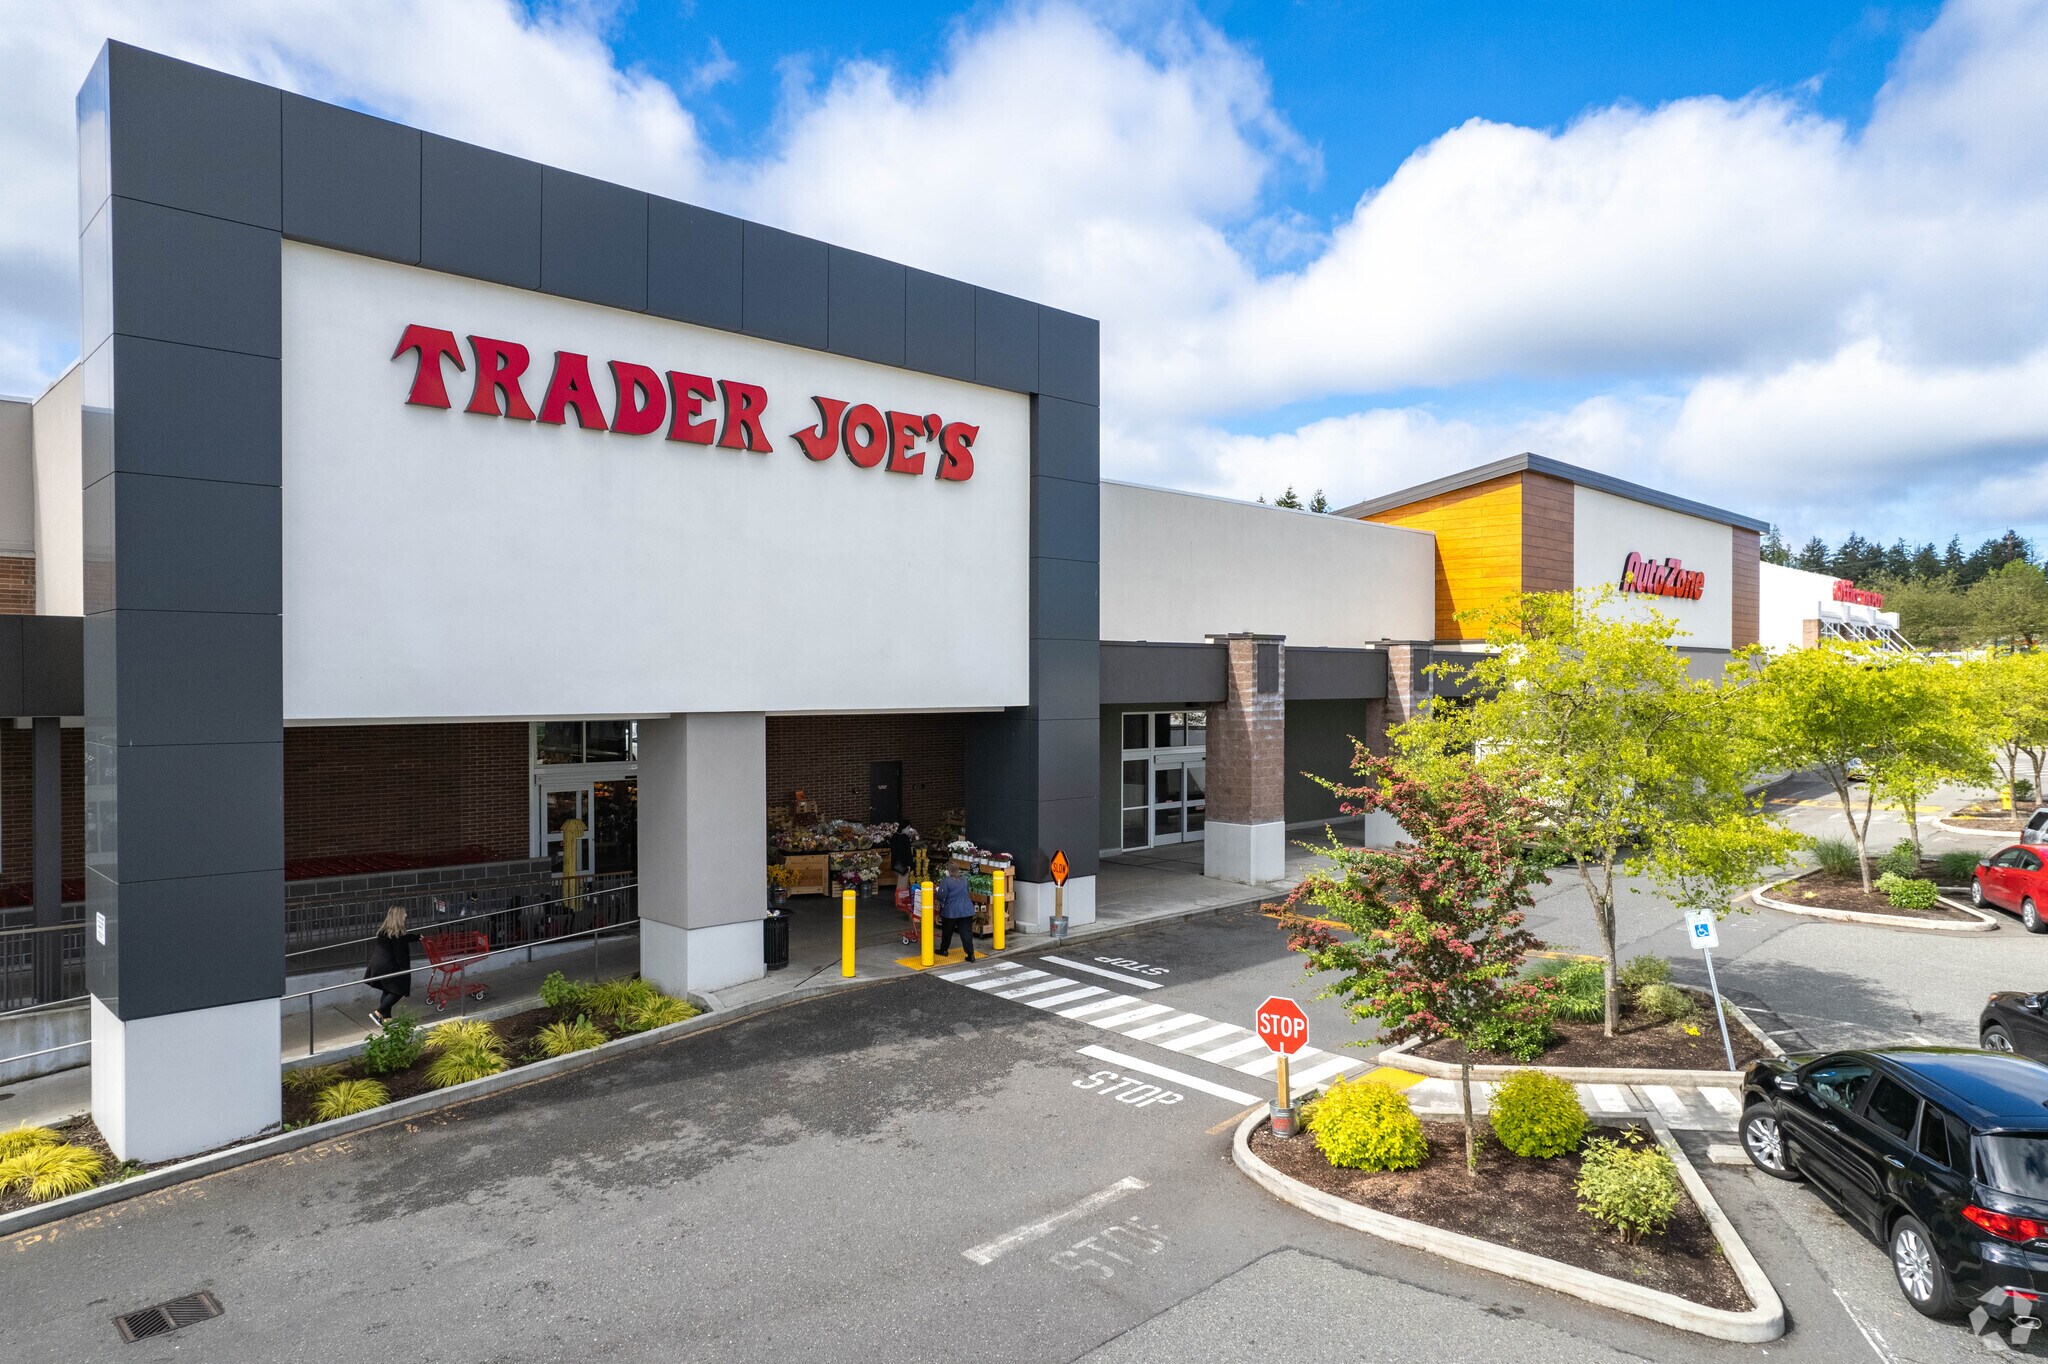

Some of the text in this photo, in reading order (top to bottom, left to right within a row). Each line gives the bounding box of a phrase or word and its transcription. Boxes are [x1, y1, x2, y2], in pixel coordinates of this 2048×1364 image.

[391, 324, 981, 482] TRADER JOE'S
[1619, 551, 1704, 600] AutoZone
[1052, 862, 1066, 874] SLOW
[1094, 956, 1170, 976] STOP
[1260, 1012, 1305, 1039] STOP
[1072, 1070, 1184, 1108] STOP
